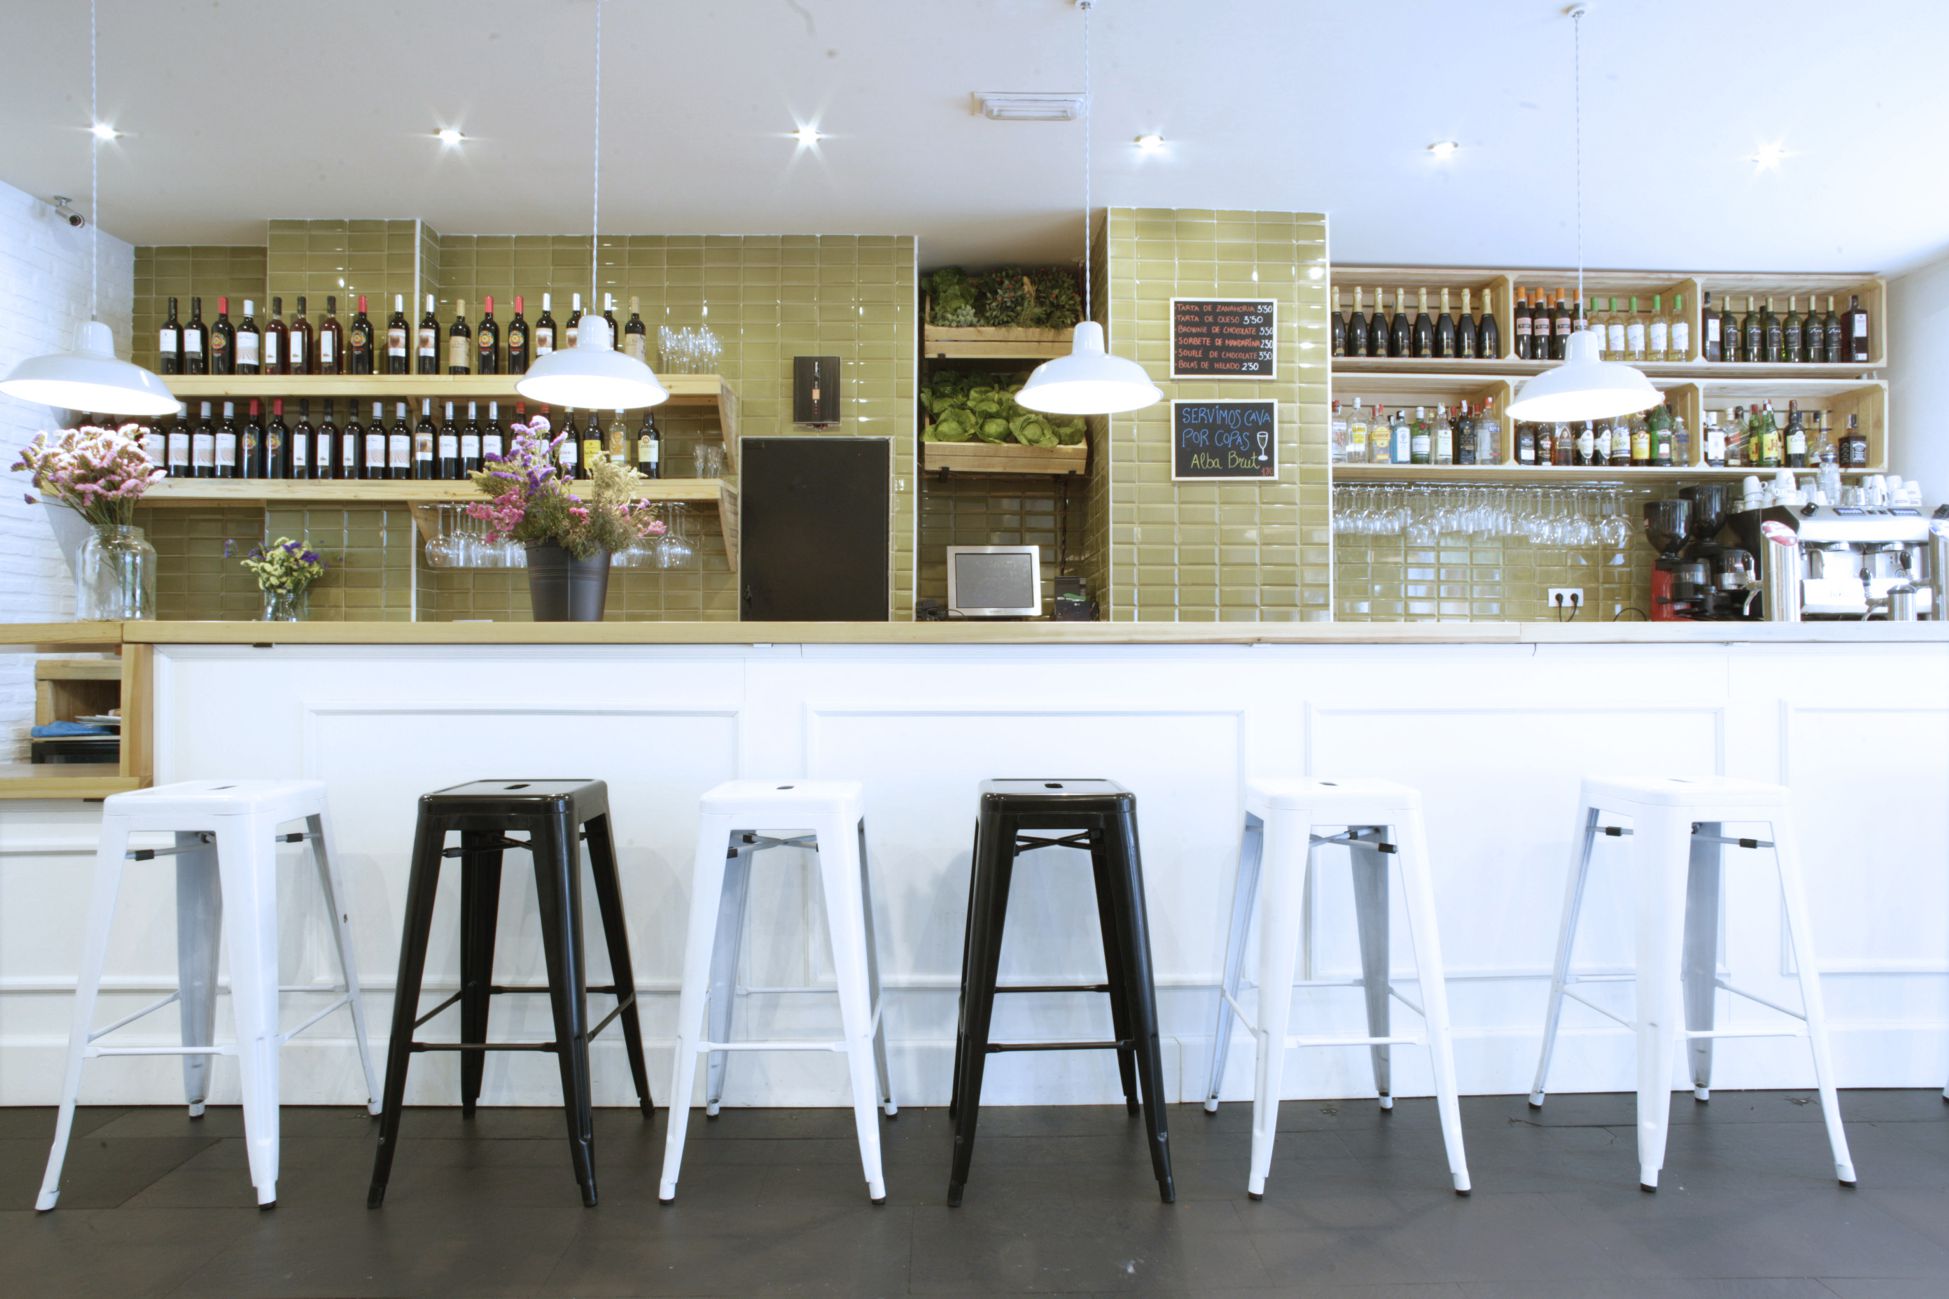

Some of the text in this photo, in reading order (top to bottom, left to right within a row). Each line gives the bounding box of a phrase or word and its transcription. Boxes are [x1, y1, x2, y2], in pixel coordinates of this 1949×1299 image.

[1204, 315, 1214, 323] DE
[1223, 326, 1257, 335] CHOCOLATE
[1178, 337, 1211, 345] SORBETE
[1178, 360, 1198, 368] BOLAS
[1201, 361, 1209, 369] DE
[1244, 409, 1271, 426] CAVA
[1182, 428, 1250, 451] POR COPAS
[1190, 450, 1260, 469] Alba Brut
